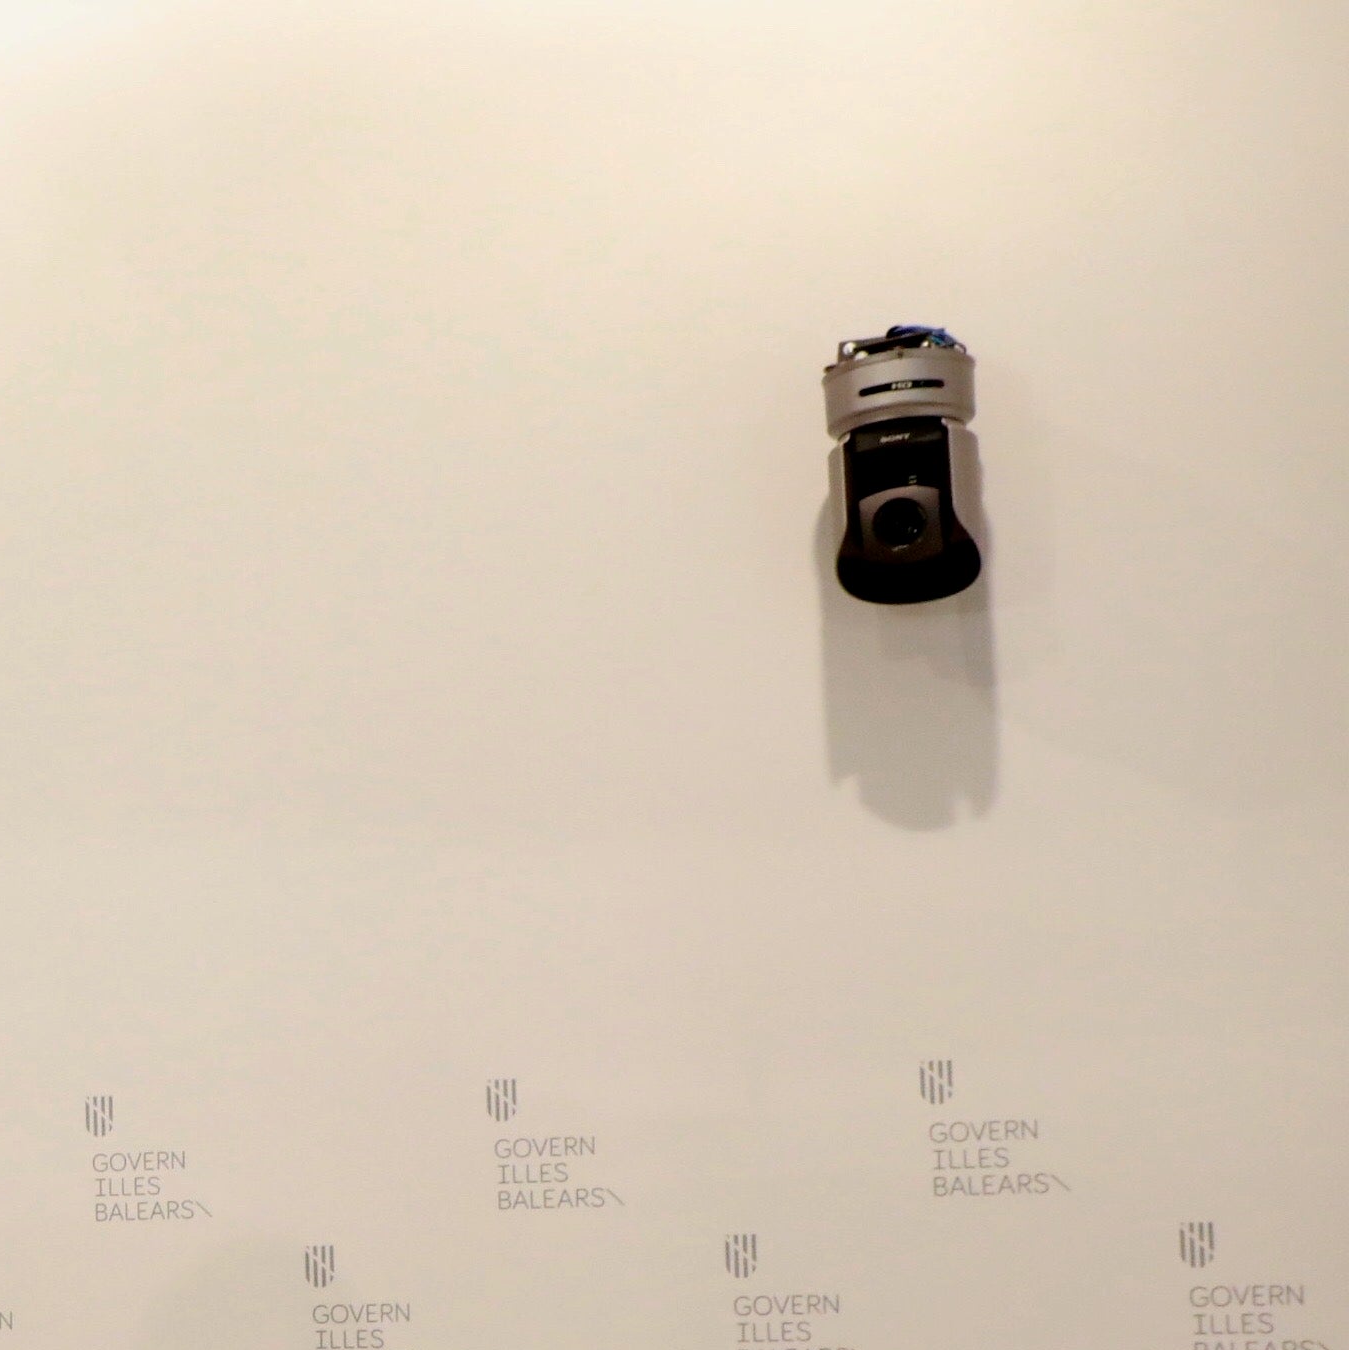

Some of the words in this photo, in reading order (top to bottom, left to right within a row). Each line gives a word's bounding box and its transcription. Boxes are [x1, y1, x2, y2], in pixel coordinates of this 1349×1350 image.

[928, 1118, 1040, 1145] GOVERN
[493, 1135, 596, 1160] GOVERN
[933, 1146, 1010, 1171] ILLES
[91, 1150, 187, 1174] GOVERN
[497, 1161, 569, 1186] ILLES
[94, 1175, 161, 1198] ILLES
[932, 1171, 1052, 1198] BALEARS
[94, 1199, 195, 1223] BALEARS
[497, 1186, 606, 1212] BALEARS
[732, 1293, 841, 1317] GOVERN
[1188, 1284, 1306, 1309] GOVERN
[311, 1302, 411, 1325] GOVERN
[1192, 1312, 1275, 1336] ILLES
[315, 1328, 385, 1350] ILLES
[736, 1320, 812, 1344] ILLES
